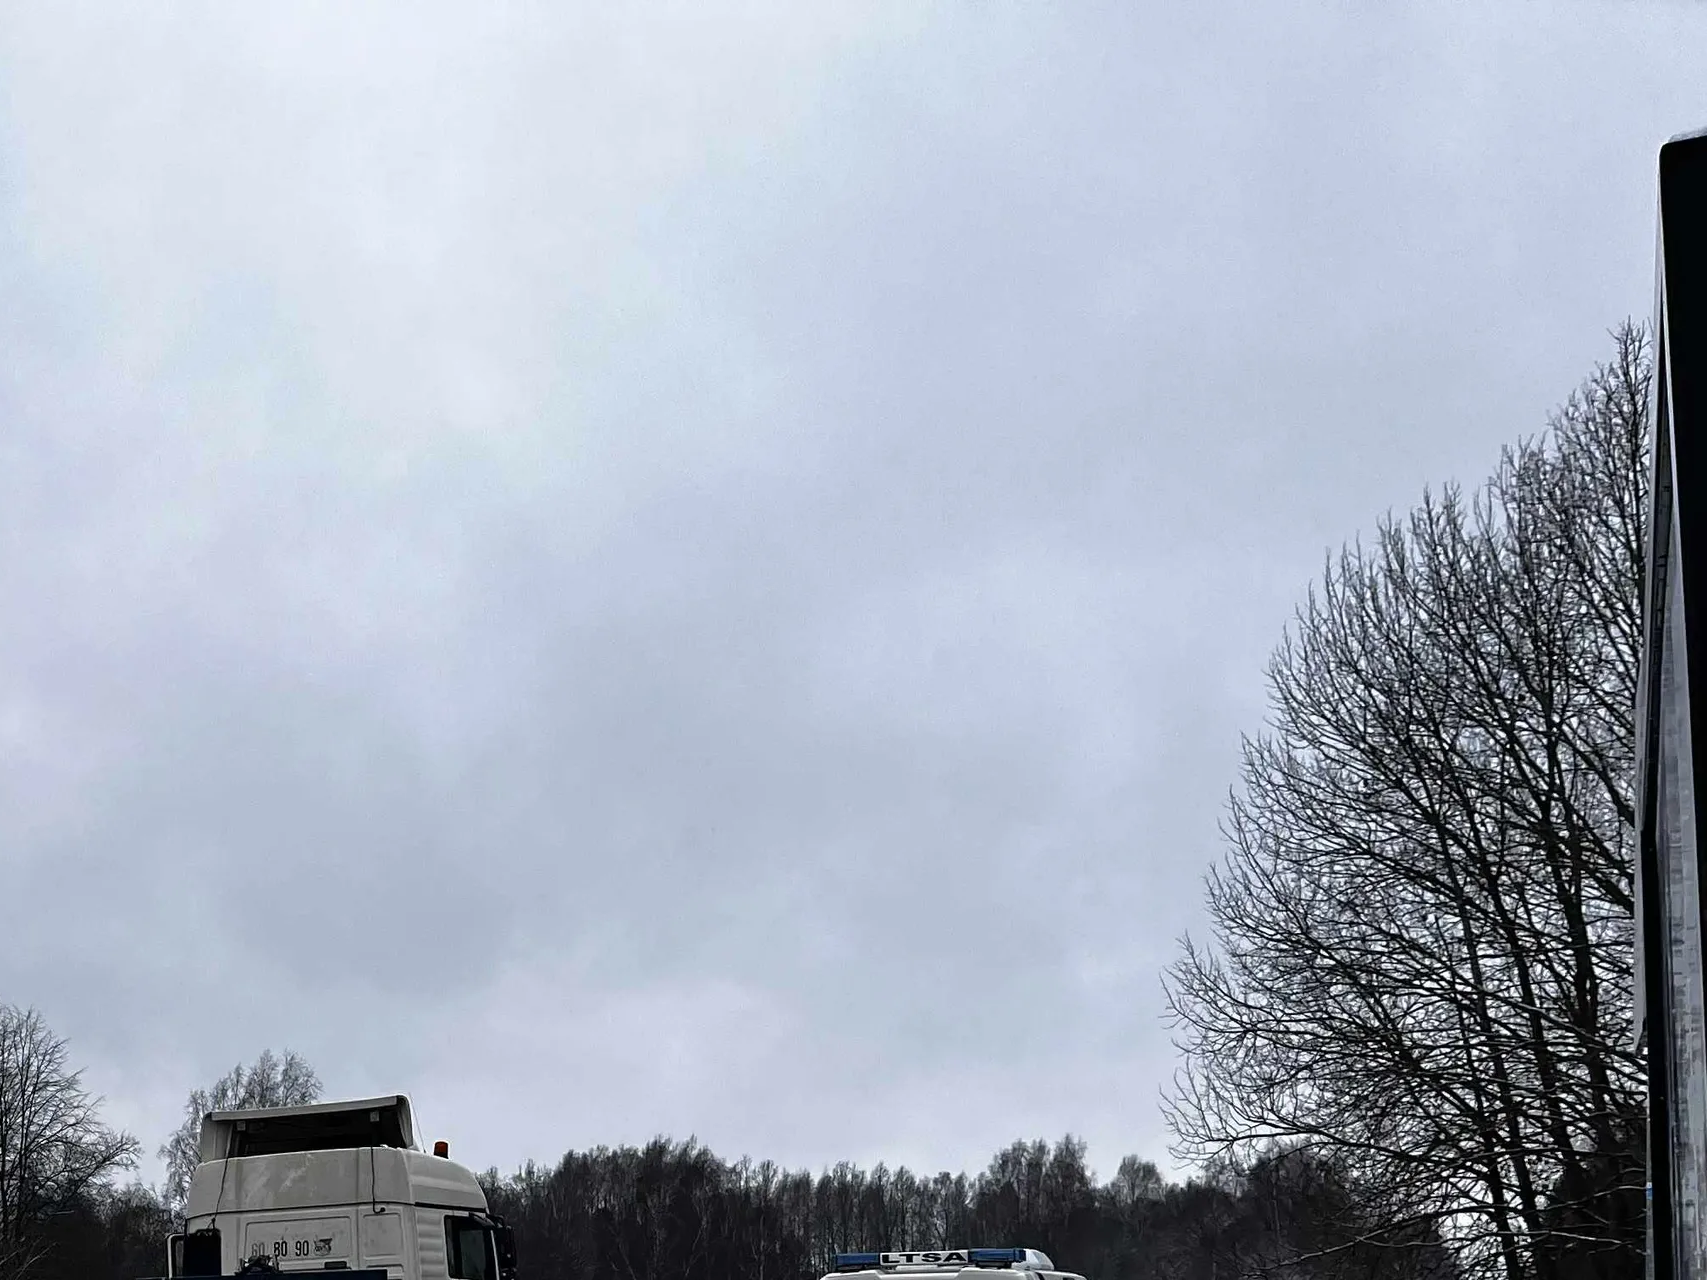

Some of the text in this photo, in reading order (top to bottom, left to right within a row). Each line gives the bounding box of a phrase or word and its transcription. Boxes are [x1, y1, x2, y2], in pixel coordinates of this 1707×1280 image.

[274, 1241, 288, 1257] 80
[295, 1240, 310, 1257] 90
[881, 1252, 967, 1263] LTSA
